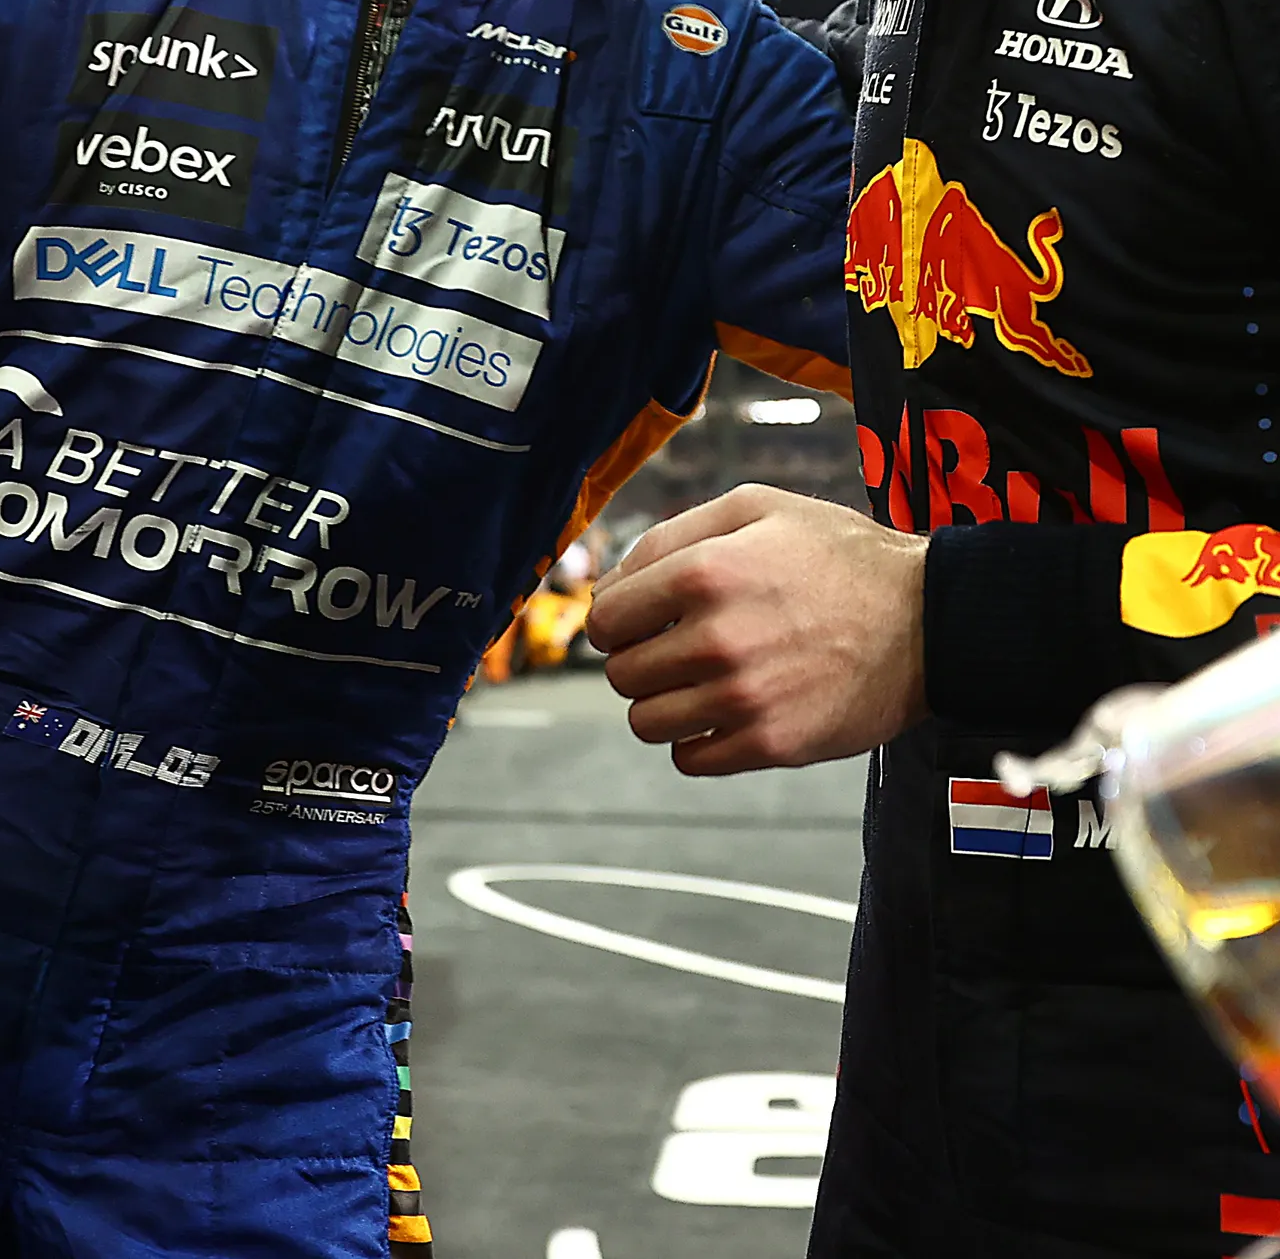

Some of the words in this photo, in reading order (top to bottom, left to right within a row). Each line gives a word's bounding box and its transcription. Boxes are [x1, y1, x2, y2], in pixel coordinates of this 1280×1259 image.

[665, 15, 722, 42] Gulf
[994, 30, 1134, 80] HONDA
[1013, 93, 1123, 159] Tezos
[99, 181, 116, 195] by
[118, 183, 168, 199] CISCO
[443, 217, 551, 283] Tezos
[35, 236, 178, 299] DELL
[198, 254, 512, 390] Technologies
[46, 427, 351, 551] BETTER
[264, 758, 395, 798] sparco
[249, 799, 288, 815] 25TH
[288, 804, 391, 825] ANNIVERSARY
